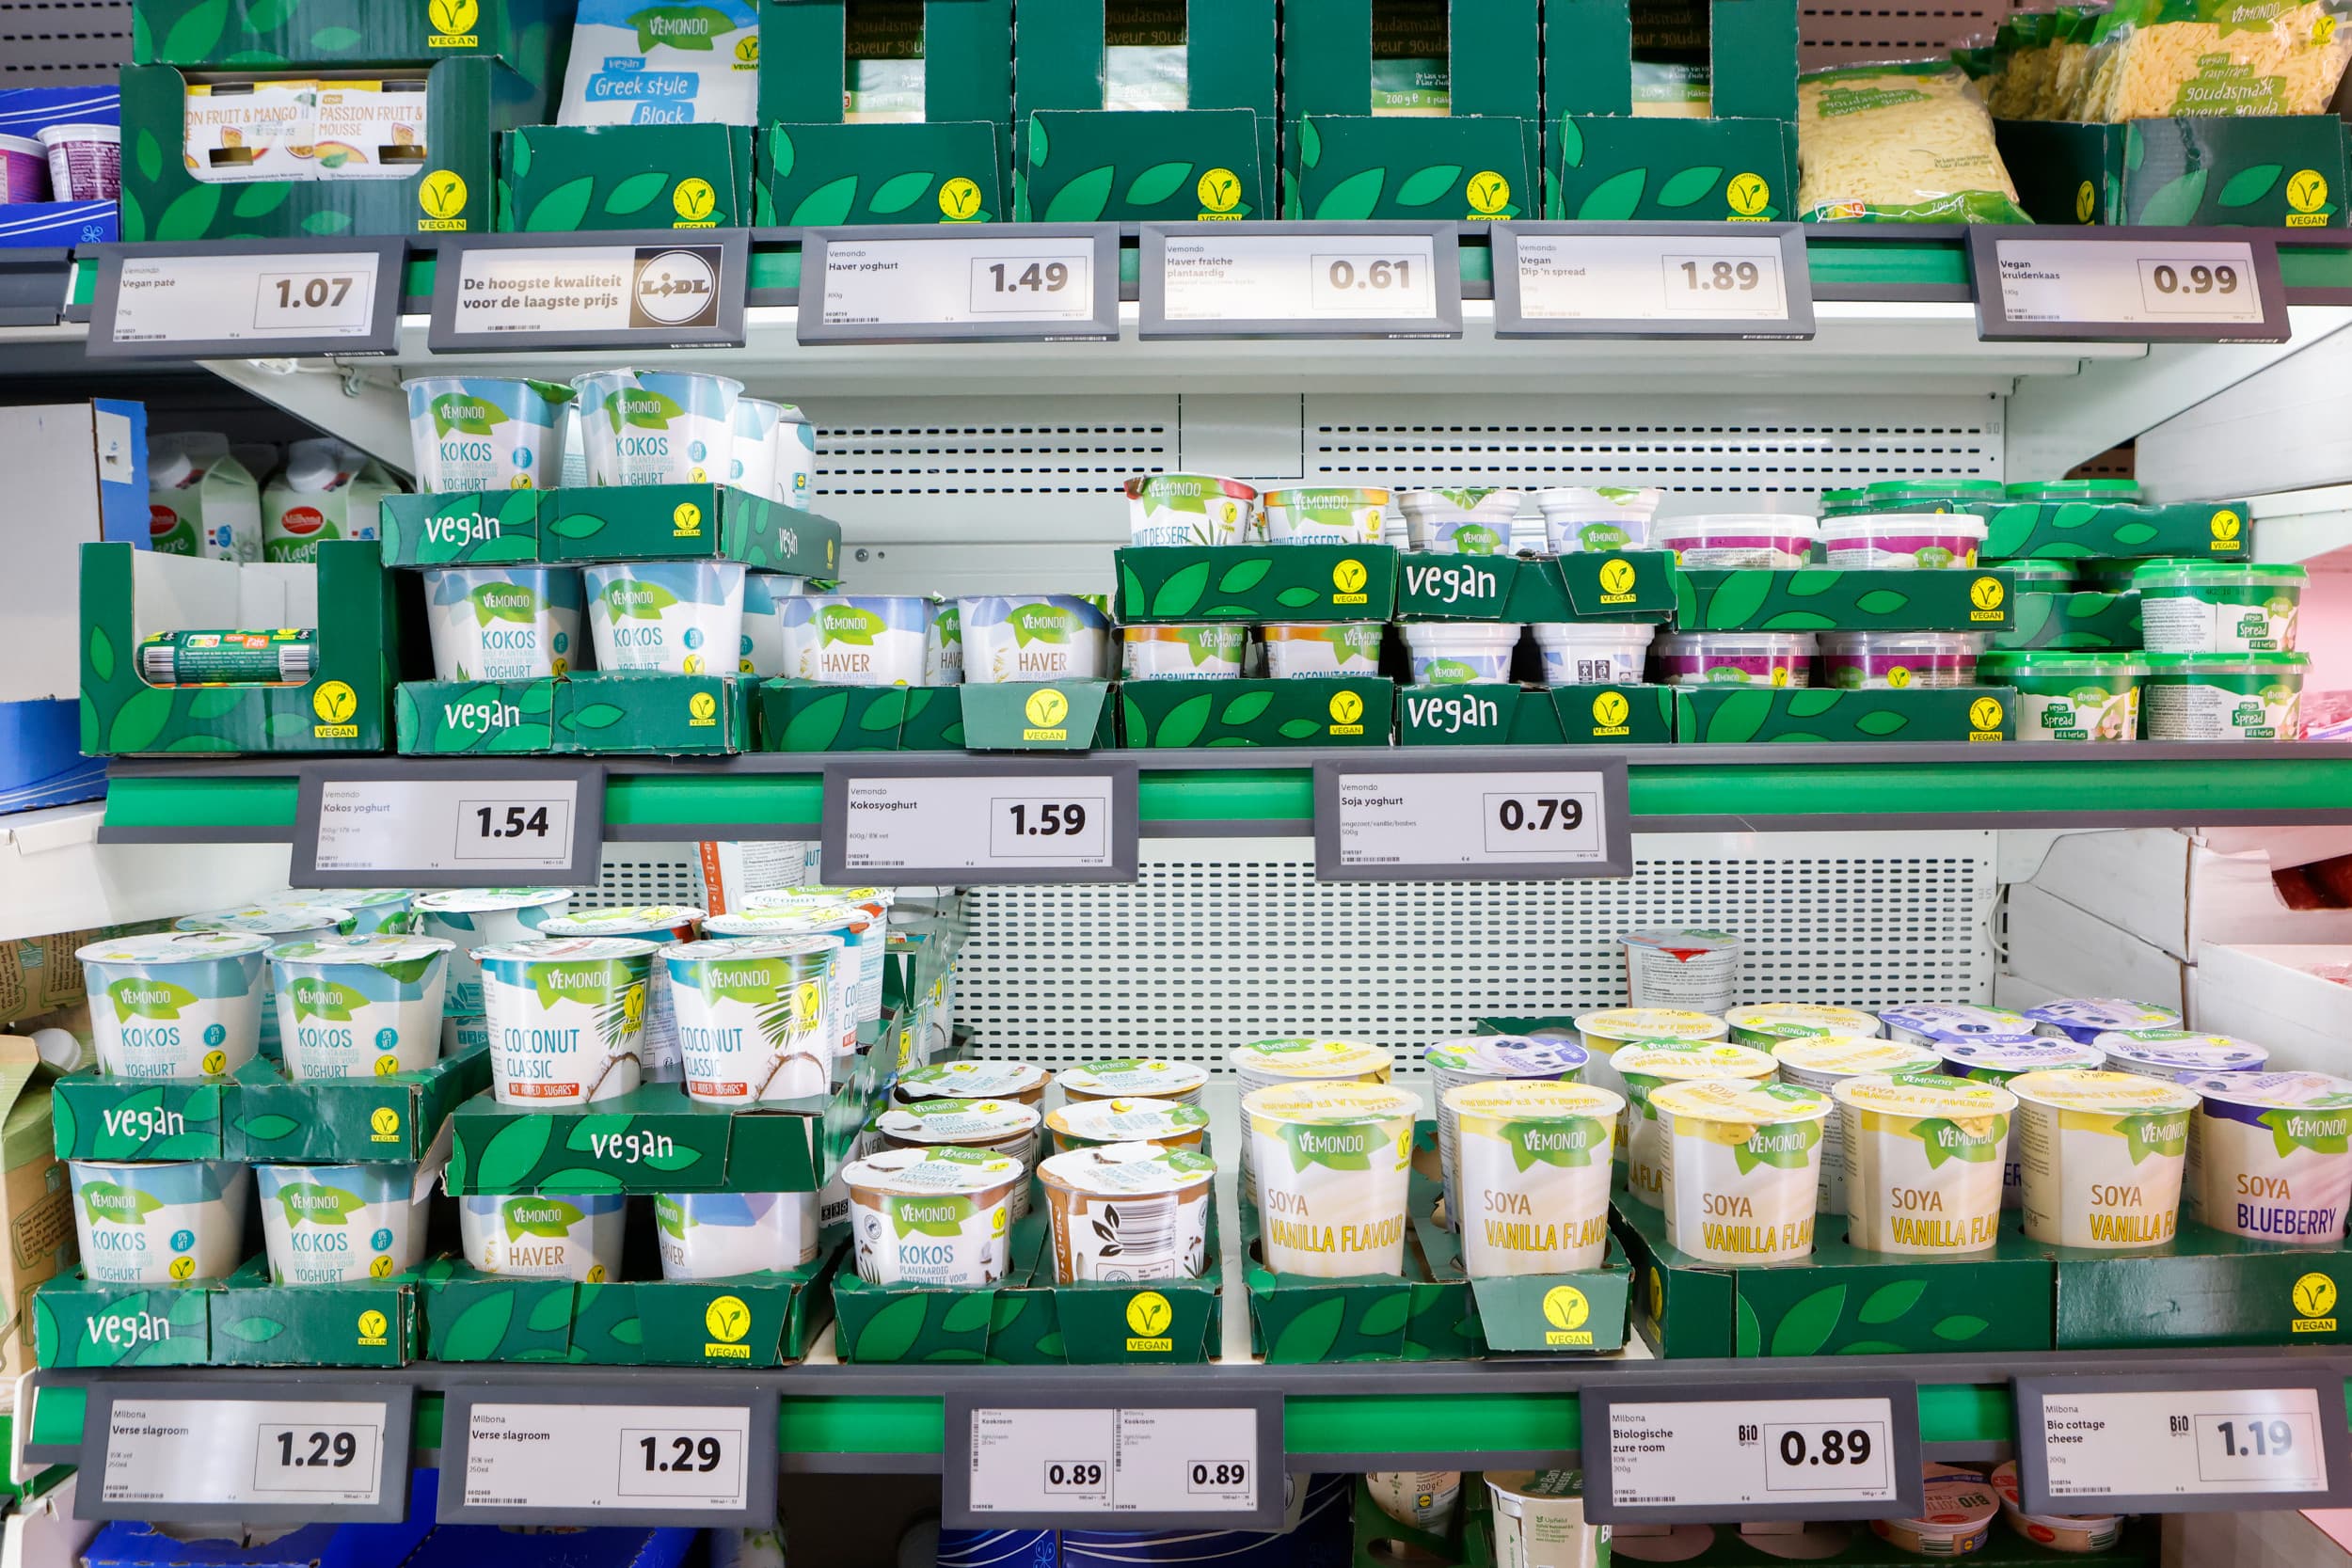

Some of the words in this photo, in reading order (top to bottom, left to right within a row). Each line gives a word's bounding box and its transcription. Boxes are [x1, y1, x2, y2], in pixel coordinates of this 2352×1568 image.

[609, 58, 640, 71] vegan
[596, 77, 641, 96] Greek
[648, 77, 688, 95] style
[1386, 94, 1402, 104] 200
[206, 108, 240, 124] FRUIT
[243, 109, 251, 121] &
[254, 107, 297, 121] MANGO
[320, 106, 374, 121] PASSION
[377, 106, 412, 121] FRUIT
[414, 107, 422, 120] &
[641, 105, 684, 125] Block
[320, 123, 362, 136] MOUSSE
[2291, 216, 2327, 226] VEGAN
[829, 262, 856, 271] Haver
[858, 261, 898, 272] yoghurt
[1168, 257, 1196, 265] Haver
[1520, 256, 1551, 265] Vegan
[2001, 260, 2031, 270] Vegan
[989, 262, 1069, 293] 1.49
[1168, 268, 1224, 279] plantaardig
[1329, 260, 1410, 291] 0.61
[1521, 267, 1537, 277] Dip
[1551, 267, 1586, 277] spread
[1680, 261, 1759, 292] 1.89
[2002, 270, 2060, 280] kruidenkaas
[2154, 264, 2238, 294] 0.99
[122, 279, 150, 289] Vegan
[153, 277, 175, 288] paté
[464, 278, 485, 290] De
[488, 277, 550, 292] hoogste
[554, 275, 622, 289] kwaliteit
[276, 277, 353, 309] 1.07
[463, 297, 498, 309] voor
[501, 296, 520, 308] de
[524, 295, 580, 309] laagste
[583, 294, 618, 309] prijs
[440, 403, 485, 420] VEMONDO
[439, 443, 492, 462] KOKOS
[615, 436, 669, 456] KOKOS
[442, 477, 487, 490] YOGHURT
[619, 472, 664, 486] YOGHURT
[1148, 482, 1202, 498] VEMONDO
[425, 512, 501, 546] vegan
[1463, 532, 1492, 545] VEMONDO
[1406, 564, 1496, 603] vegan
[612, 590, 654, 605] VEMONDO
[1335, 594, 1365, 603] VEGAN
[1022, 615, 1065, 630] VEMONDO
[2239, 623, 2268, 637] Spread
[612, 627, 663, 648] KOKOS
[821, 654, 870, 673] HAVER
[1019, 652, 1067, 672] HAVER
[1434, 668, 1464, 678] VEMONDO
[445, 700, 520, 734] vegan
[1407, 694, 1498, 734] vegan
[1026, 730, 1064, 740] VEGAN
[325, 790, 360, 799] Vemondo
[850, 787, 887, 796] Vemondo
[1341, 783, 1378, 791] Vemondo
[324, 804, 352, 813] Kokos
[354, 803, 390, 814] yoghurt
[850, 800, 917, 811] Kokosyoghurt
[1342, 797, 1363, 807] Soja
[1365, 796, 1404, 808] yoghurt
[476, 806, 548, 838] 1.54
[1009, 804, 1086, 836] 1.59
[1499, 799, 1583, 832] 0.79
[708, 968, 771, 988] VEMONDO
[297, 989, 343, 1006] VEMONDO
[120, 1027, 181, 1047] KOKOS
[505, 1028, 580, 1053] COCONUT
[681, 1028, 743, 1053] COCONUT
[125, 1063, 176, 1078] YOGHURT
[506, 1058, 553, 1079] CLASSIC
[1088, 1061, 1129, 1073] VEMONDO
[1902, 1074, 1953, 1086] VEMONDO
[511, 1085, 520, 1095] NO
[521, 1085, 541, 1095] ADDED
[103, 1106, 184, 1142] vegan
[591, 1130, 674, 1164] vegan
[1523, 1130, 1587, 1150] VEMONDO
[938, 1148, 987, 1162] VEMONDO
[2236, 1173, 2291, 1200] SOYA
[90, 1191, 135, 1209] VEMONDO
[1268, 1188, 1309, 1216] SOYA
[1702, 1193, 1753, 1218] SOYA
[1891, 1187, 1943, 1212] SOYA
[513, 1208, 562, 1224] VEMONDO
[2237, 1203, 2337, 1236] BLUEBERRY
[1270, 1216, 1336, 1253] VANILLA
[1341, 1214, 1404, 1253] FLAVOUR
[1485, 1219, 1557, 1251] VANILLA
[1891, 1216, 1966, 1247] VANILLA
[2090, 1213, 2161, 1243] VANILLA
[92, 1229, 146, 1251] KOKOS
[292, 1232, 348, 1253] KOKOS
[509, 1245, 564, 1266] HAVER
[96, 1265, 142, 1282] YOGHURT
[295, 1268, 343, 1283] YOGHURT
[899, 1265, 949, 1275] PLANTAARDIG
[87, 1312, 170, 1347] vegan
[1549, 1334, 1590, 1344] VEGAN
[707, 1347, 748, 1358] VEGAN
[114, 1410, 147, 1418] Milbona
[2045, 1404, 2078, 1414] Milbona
[472, 1415, 506, 1423] Milbona
[1612, 1414, 1646, 1422] Milbona
[2046, 1419, 2063, 1429] Bio
[2066, 1419, 2106, 1432] cottage
[112, 1425, 140, 1435] Verse
[142, 1426, 189, 1437] slagroom
[471, 1430, 501, 1440] Verse
[502, 1430, 550, 1443] slagroom
[1613, 1429, 1674, 1440] Biologische
[2047, 1433, 2083, 1444] cheese
[2217, 1420, 2293, 1457] 1.19
[277, 1431, 357, 1467] 1.29
[640, 1436, 722, 1472] 1.29
[1613, 1444, 1636, 1453] zure
[1641, 1443, 1665, 1452] room
[1781, 1430, 1872, 1466] 0.89
[1049, 1465, 1102, 1485] 0.89
[1192, 1465, 1245, 1485] 0.89
